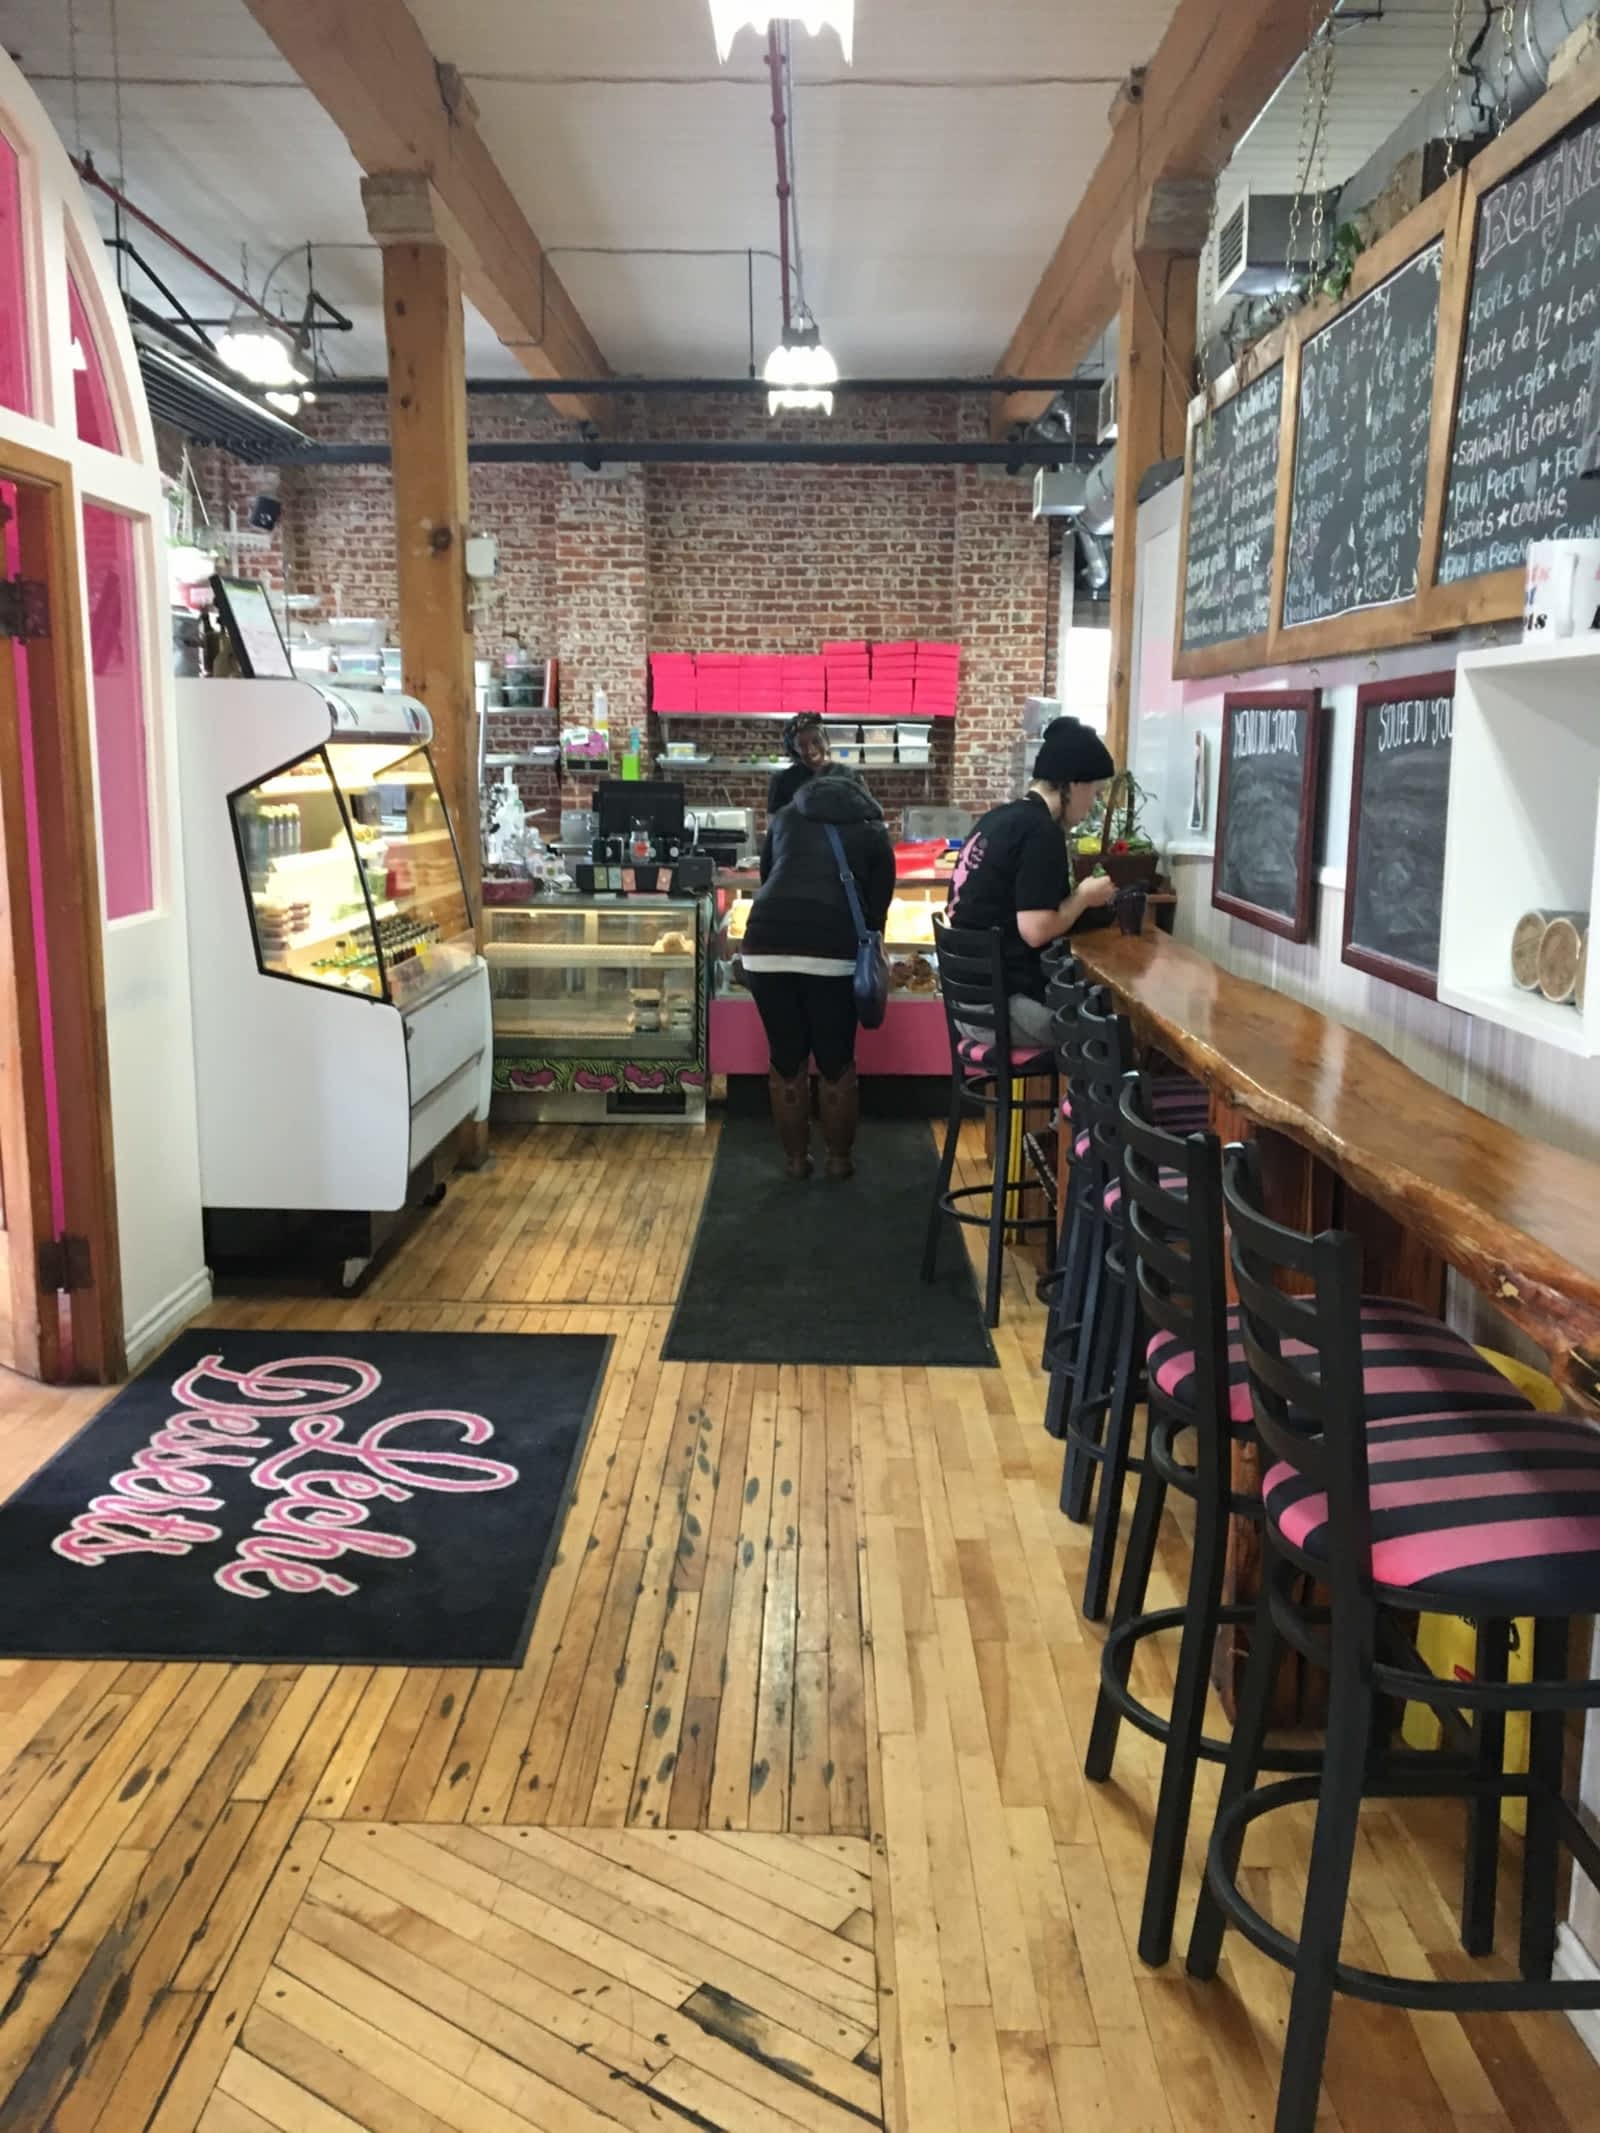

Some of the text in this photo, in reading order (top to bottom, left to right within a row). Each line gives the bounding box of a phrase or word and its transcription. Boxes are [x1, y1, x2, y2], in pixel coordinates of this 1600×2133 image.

[1512, 311, 1530, 352] de
[1535, 302, 1552, 351] 12
[1271, 709, 1299, 757] JOUR
[1378, 701, 1411, 752] SOUPE
[1412, 698, 1428, 743] DU
[52, 1354, 381, 1565] Desserts
